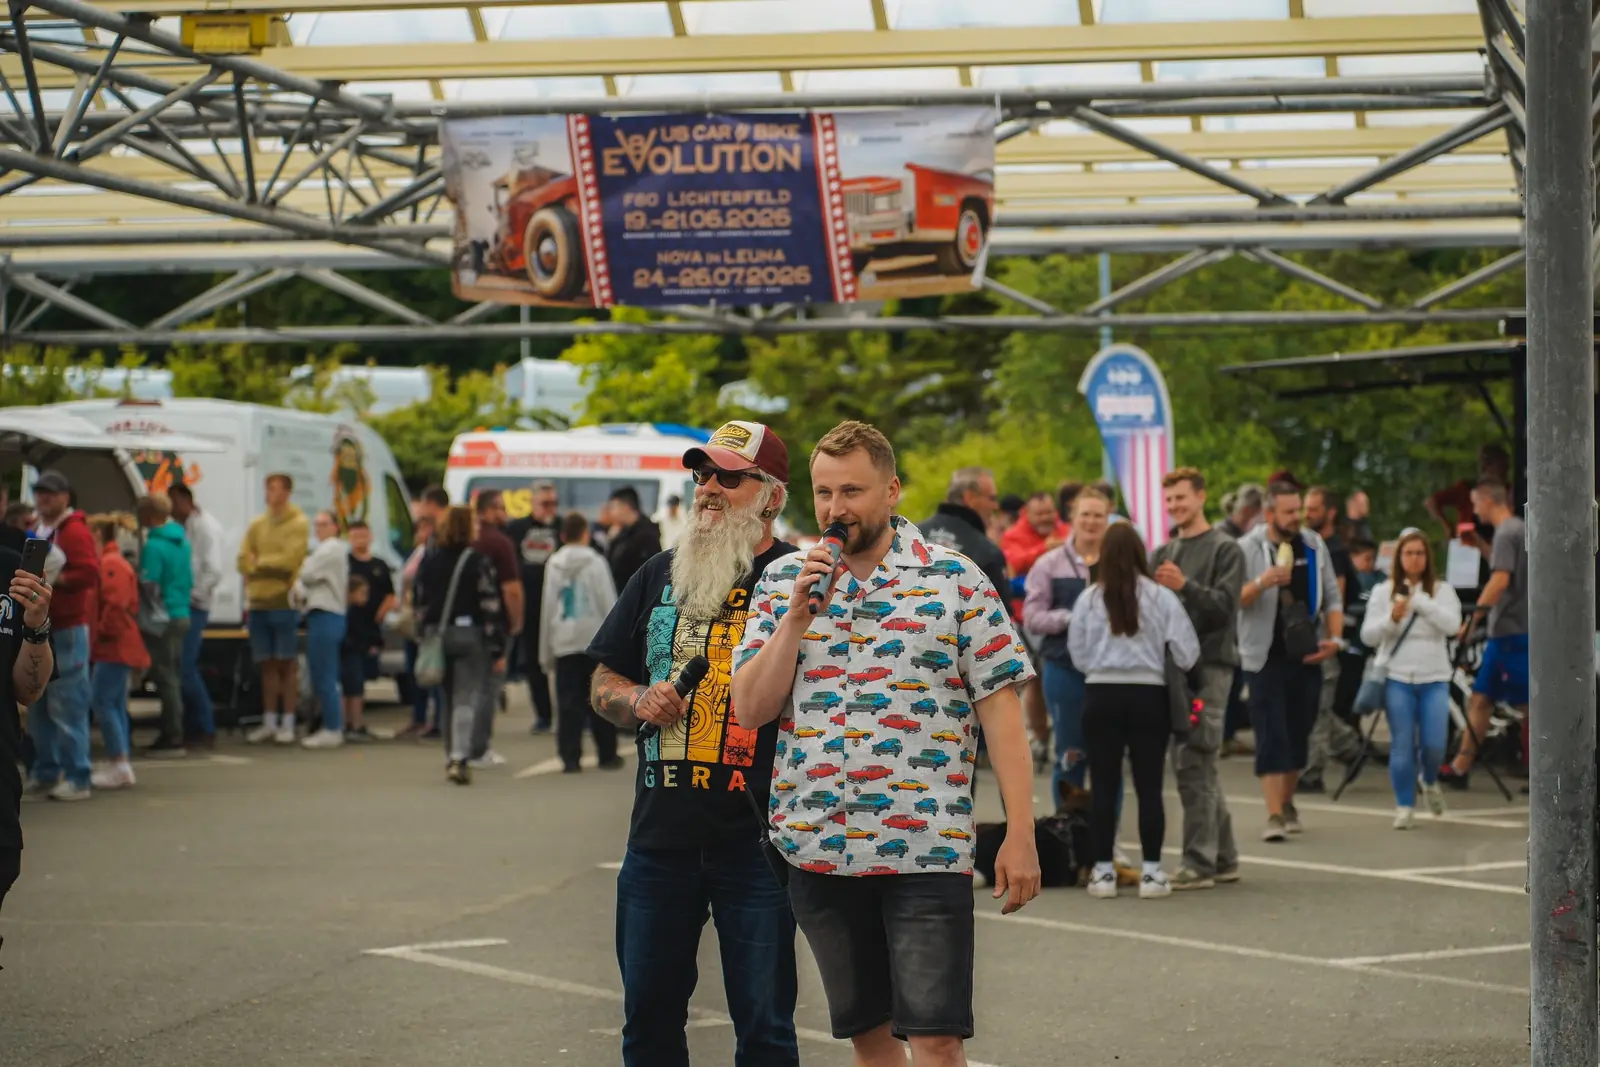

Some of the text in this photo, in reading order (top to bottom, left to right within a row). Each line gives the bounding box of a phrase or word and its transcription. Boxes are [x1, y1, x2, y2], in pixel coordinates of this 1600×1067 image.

[660, 125, 690, 142] US
[692, 123, 733, 142] CAR
[754, 123, 800, 141] BIKE
[602, 128, 802, 175] EVOLUTION
[668, 190, 791, 206] LICHTERFELD
[723, 248, 786, 264] LEUNA
[644, 765, 746, 792] GERA
